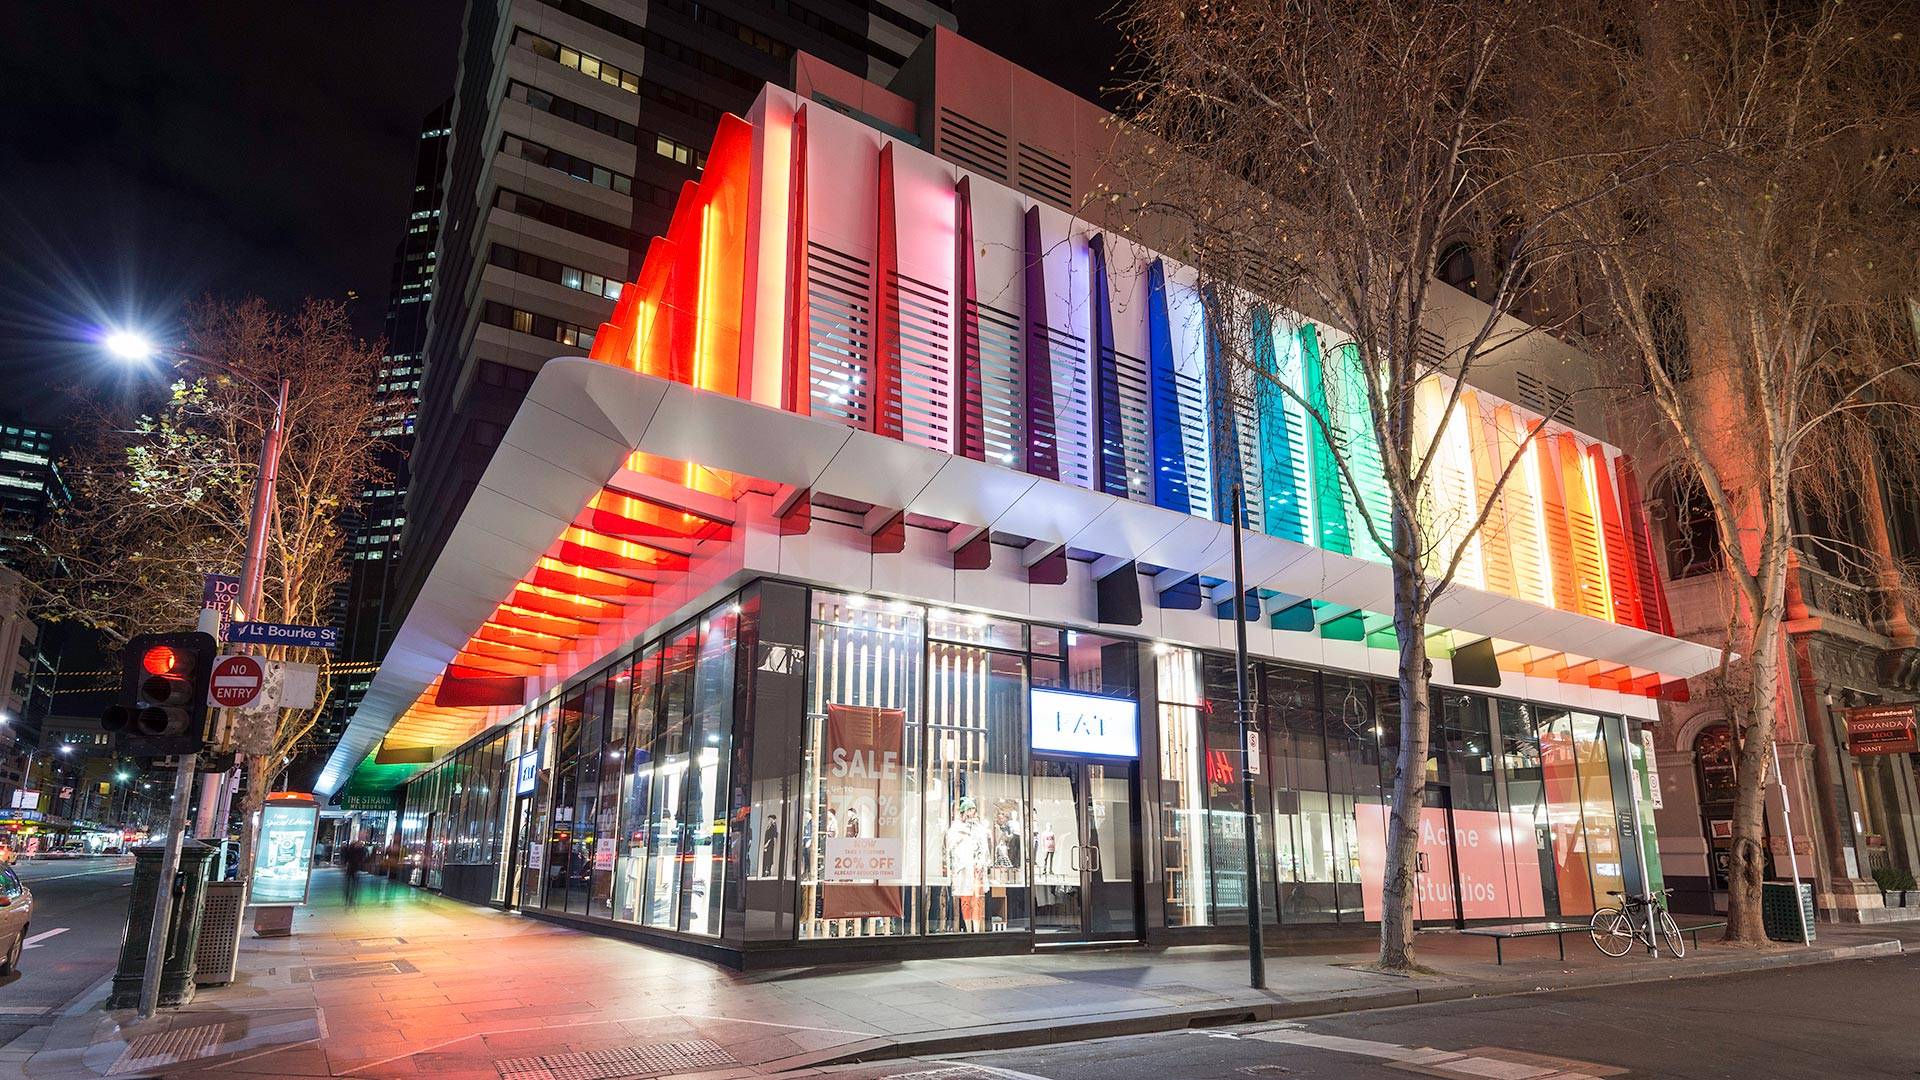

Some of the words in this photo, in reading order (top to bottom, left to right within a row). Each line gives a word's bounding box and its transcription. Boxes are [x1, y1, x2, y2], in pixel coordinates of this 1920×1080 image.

[215, 581, 239, 594] DO
[215, 592, 234, 602] YO
[250, 626, 263, 636] Lt
[268, 628, 316, 639] Bourke
[320, 631, 336, 641] St
[230, 665, 247, 675] NO
[216, 687, 253, 699] ENTRY
[1853, 721, 1903, 730] TOWANDA
[832, 747, 897, 780] SALE
[347, 795, 360, 805] THE
[361, 796, 392, 805] STRAND
[834, 857, 865, 869] 20%
[869, 857, 894, 869] OFF
